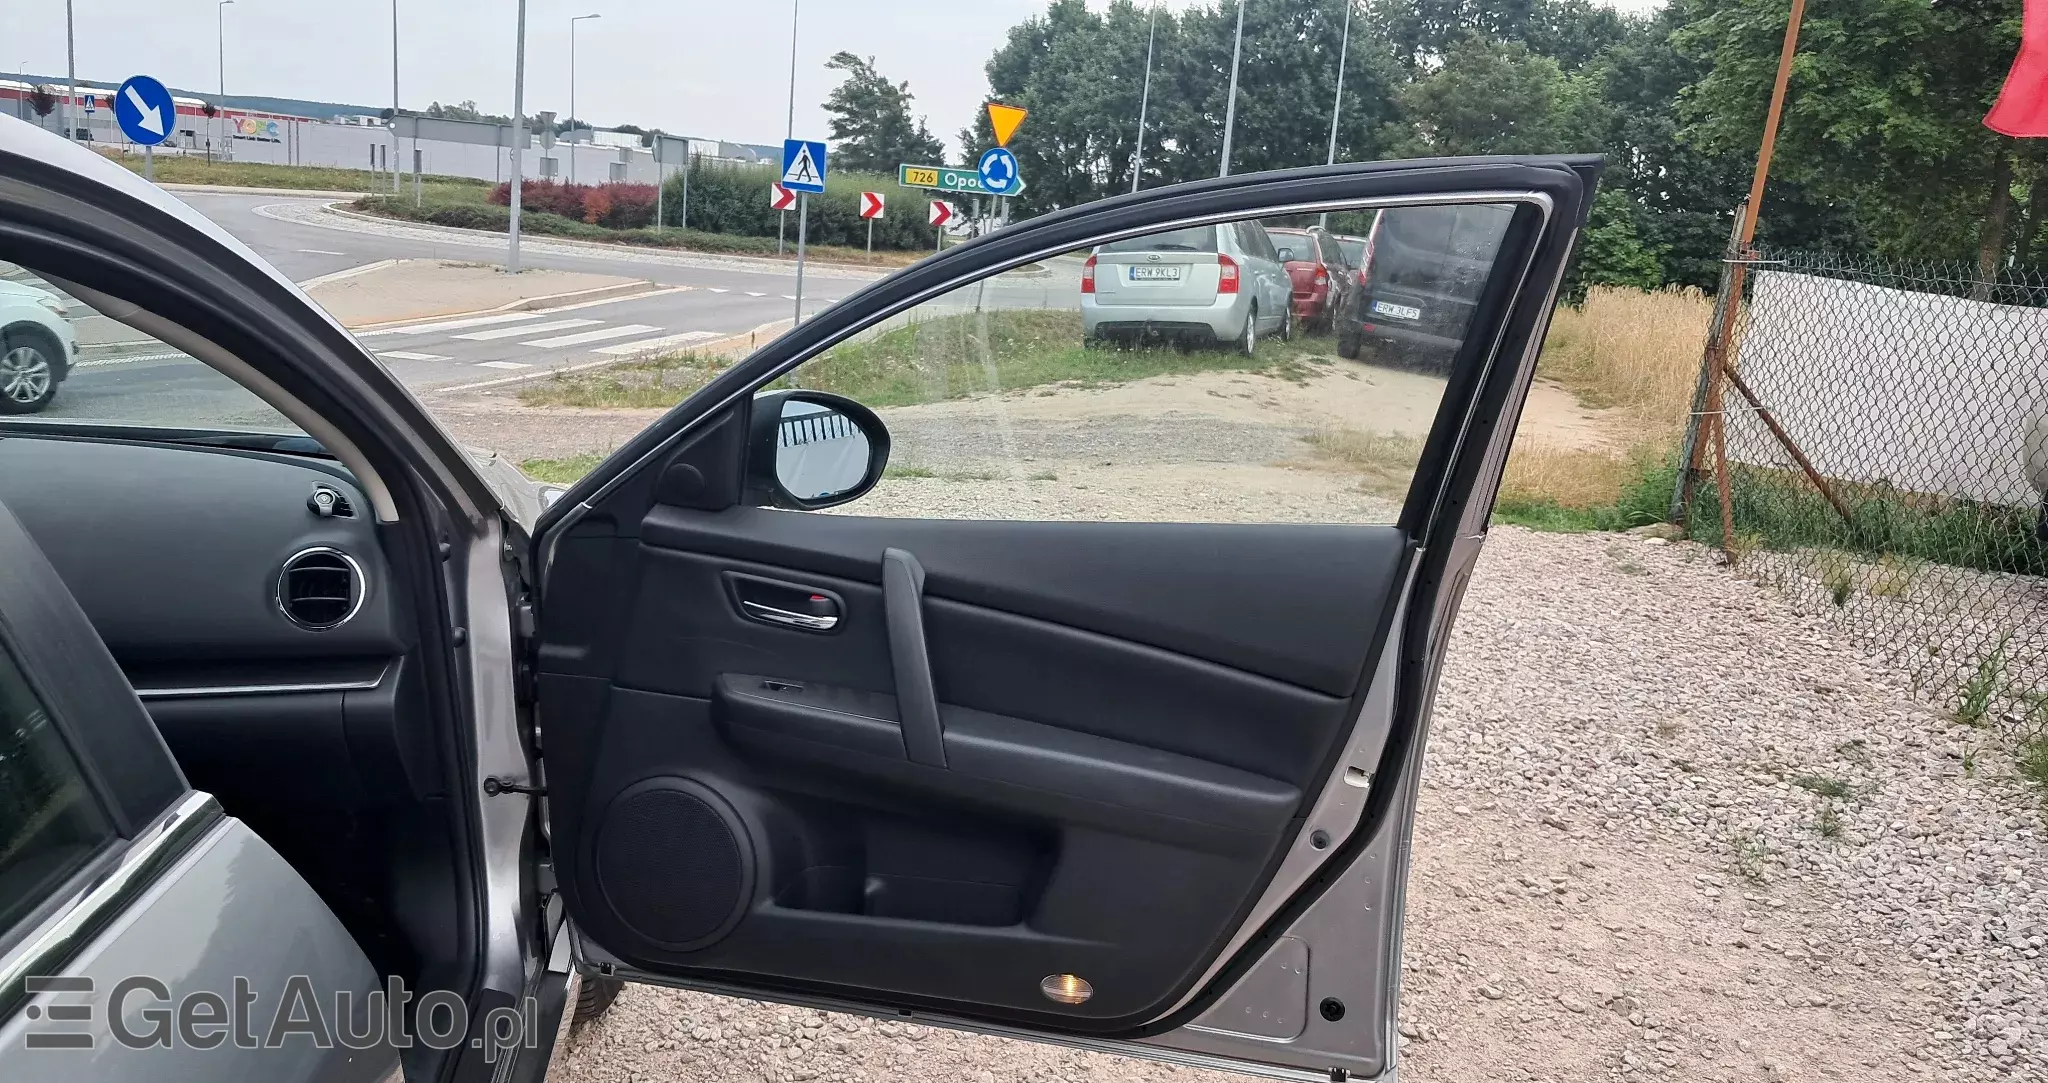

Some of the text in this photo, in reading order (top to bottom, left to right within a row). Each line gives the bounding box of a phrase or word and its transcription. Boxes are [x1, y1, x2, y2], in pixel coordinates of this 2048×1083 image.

[913, 171, 934, 183] 726
[1135, 268, 1178, 277] ERW 9KL3
[1377, 303, 1394, 314] ERW
